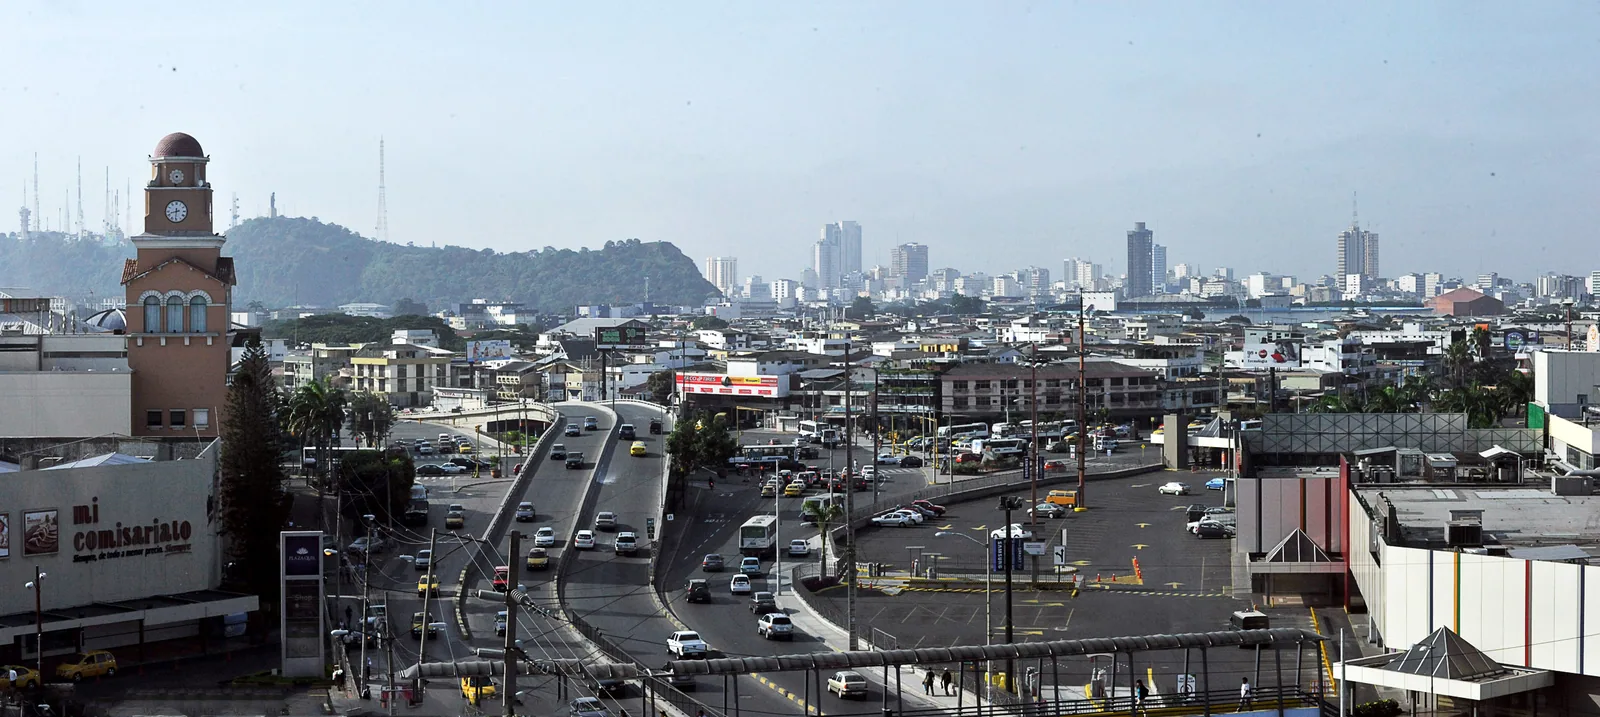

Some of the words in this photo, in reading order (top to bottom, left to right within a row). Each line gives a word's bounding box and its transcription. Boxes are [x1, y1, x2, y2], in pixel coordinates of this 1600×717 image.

[73, 496, 99, 525] mi
[73, 518, 192, 552] comisariato
[98, 551, 106, 560] de
[107, 550, 120, 559] todo
[126, 548, 145, 557] menor
